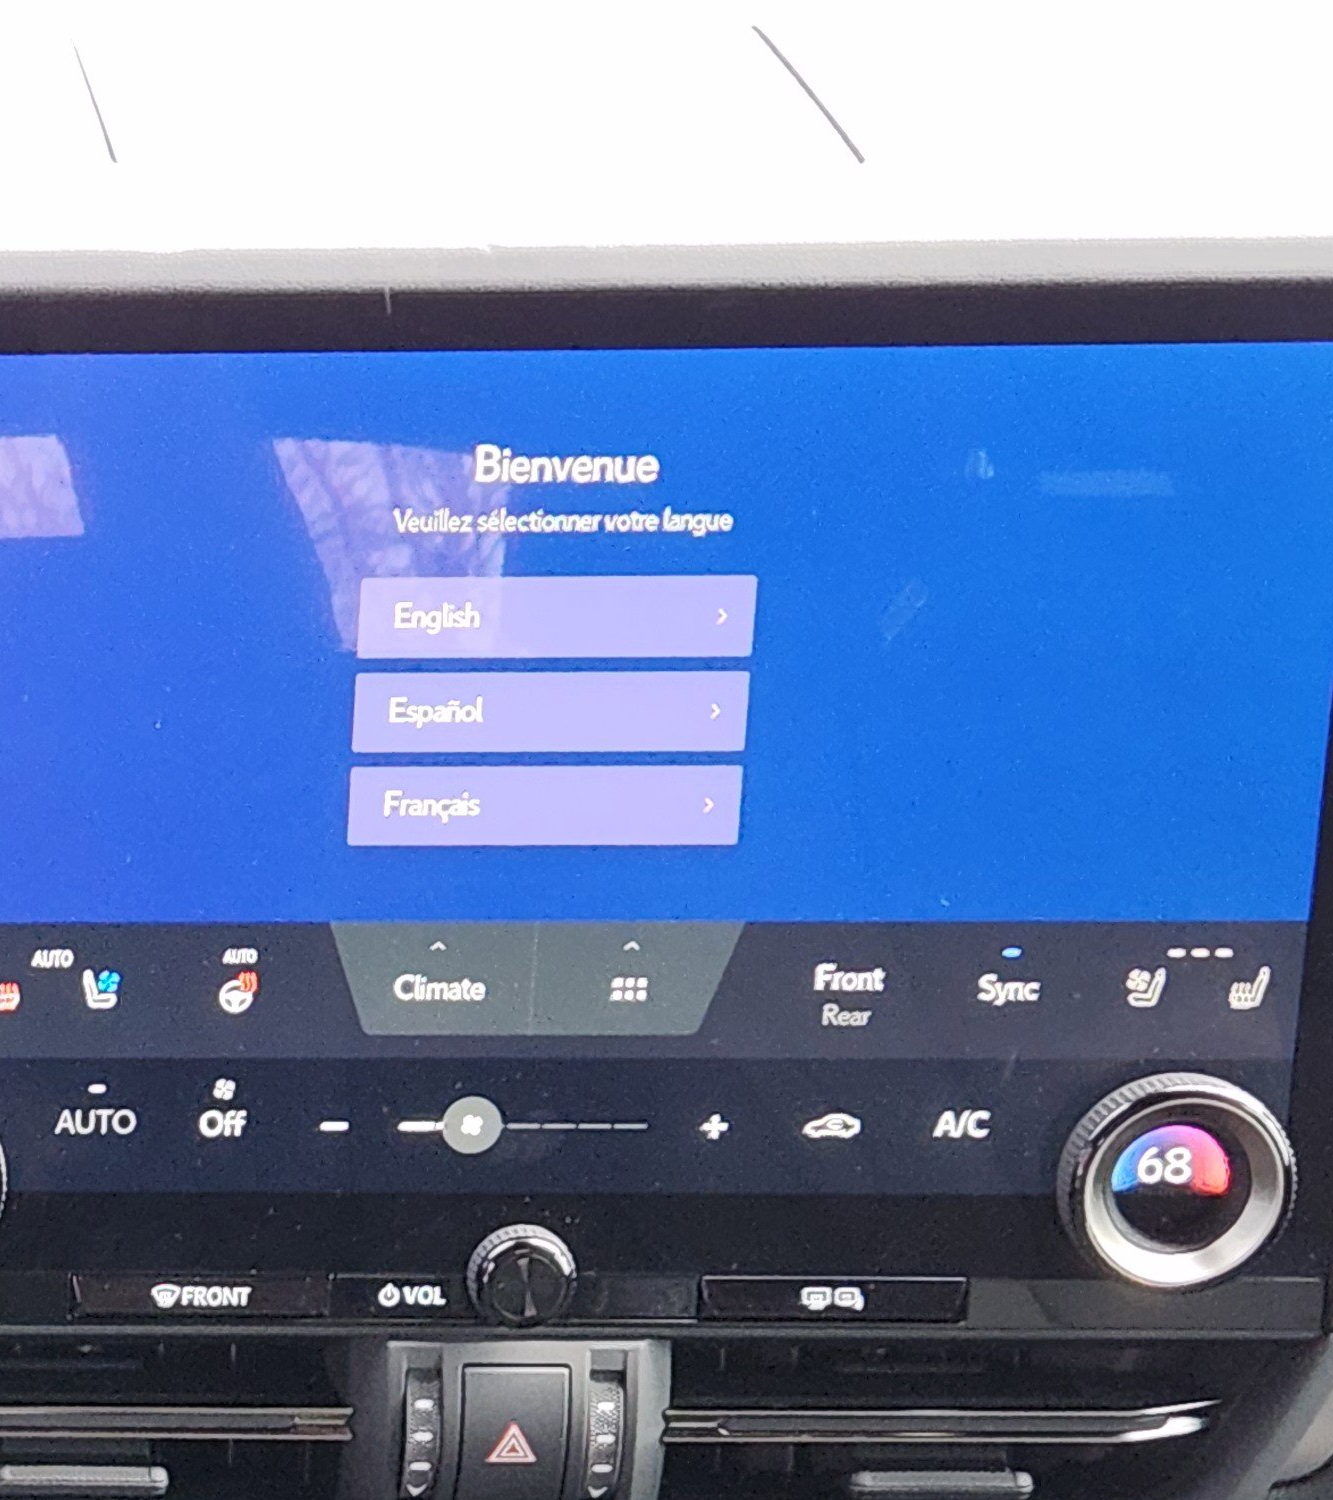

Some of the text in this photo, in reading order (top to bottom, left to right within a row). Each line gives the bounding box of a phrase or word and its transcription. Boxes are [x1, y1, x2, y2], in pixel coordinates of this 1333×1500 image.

[474, 444, 660, 484] Bienvenue
[393, 507, 733, 537] Veuillez sélectionner votre langue
[394, 601, 481, 634] English
[388, 696, 484, 729] Español
[383, 790, 481, 823] Français
[31, 949, 74, 969] AUTO
[222, 948, 259, 965] AUTO
[393, 974, 486, 1002] Climate
[813, 963, 886, 992] Front
[977, 974, 1041, 1006] Sync
[821, 1004, 872, 1027] Rear
[54, 1108, 137, 1136] AUTO
[198, 1109, 247, 1138] Off
[933, 1109, 991, 1139] A/C
[1136, 1147, 1192, 1184] 68
[180, 1286, 253, 1307] FRONT
[403, 1286, 447, 1306] VOL
